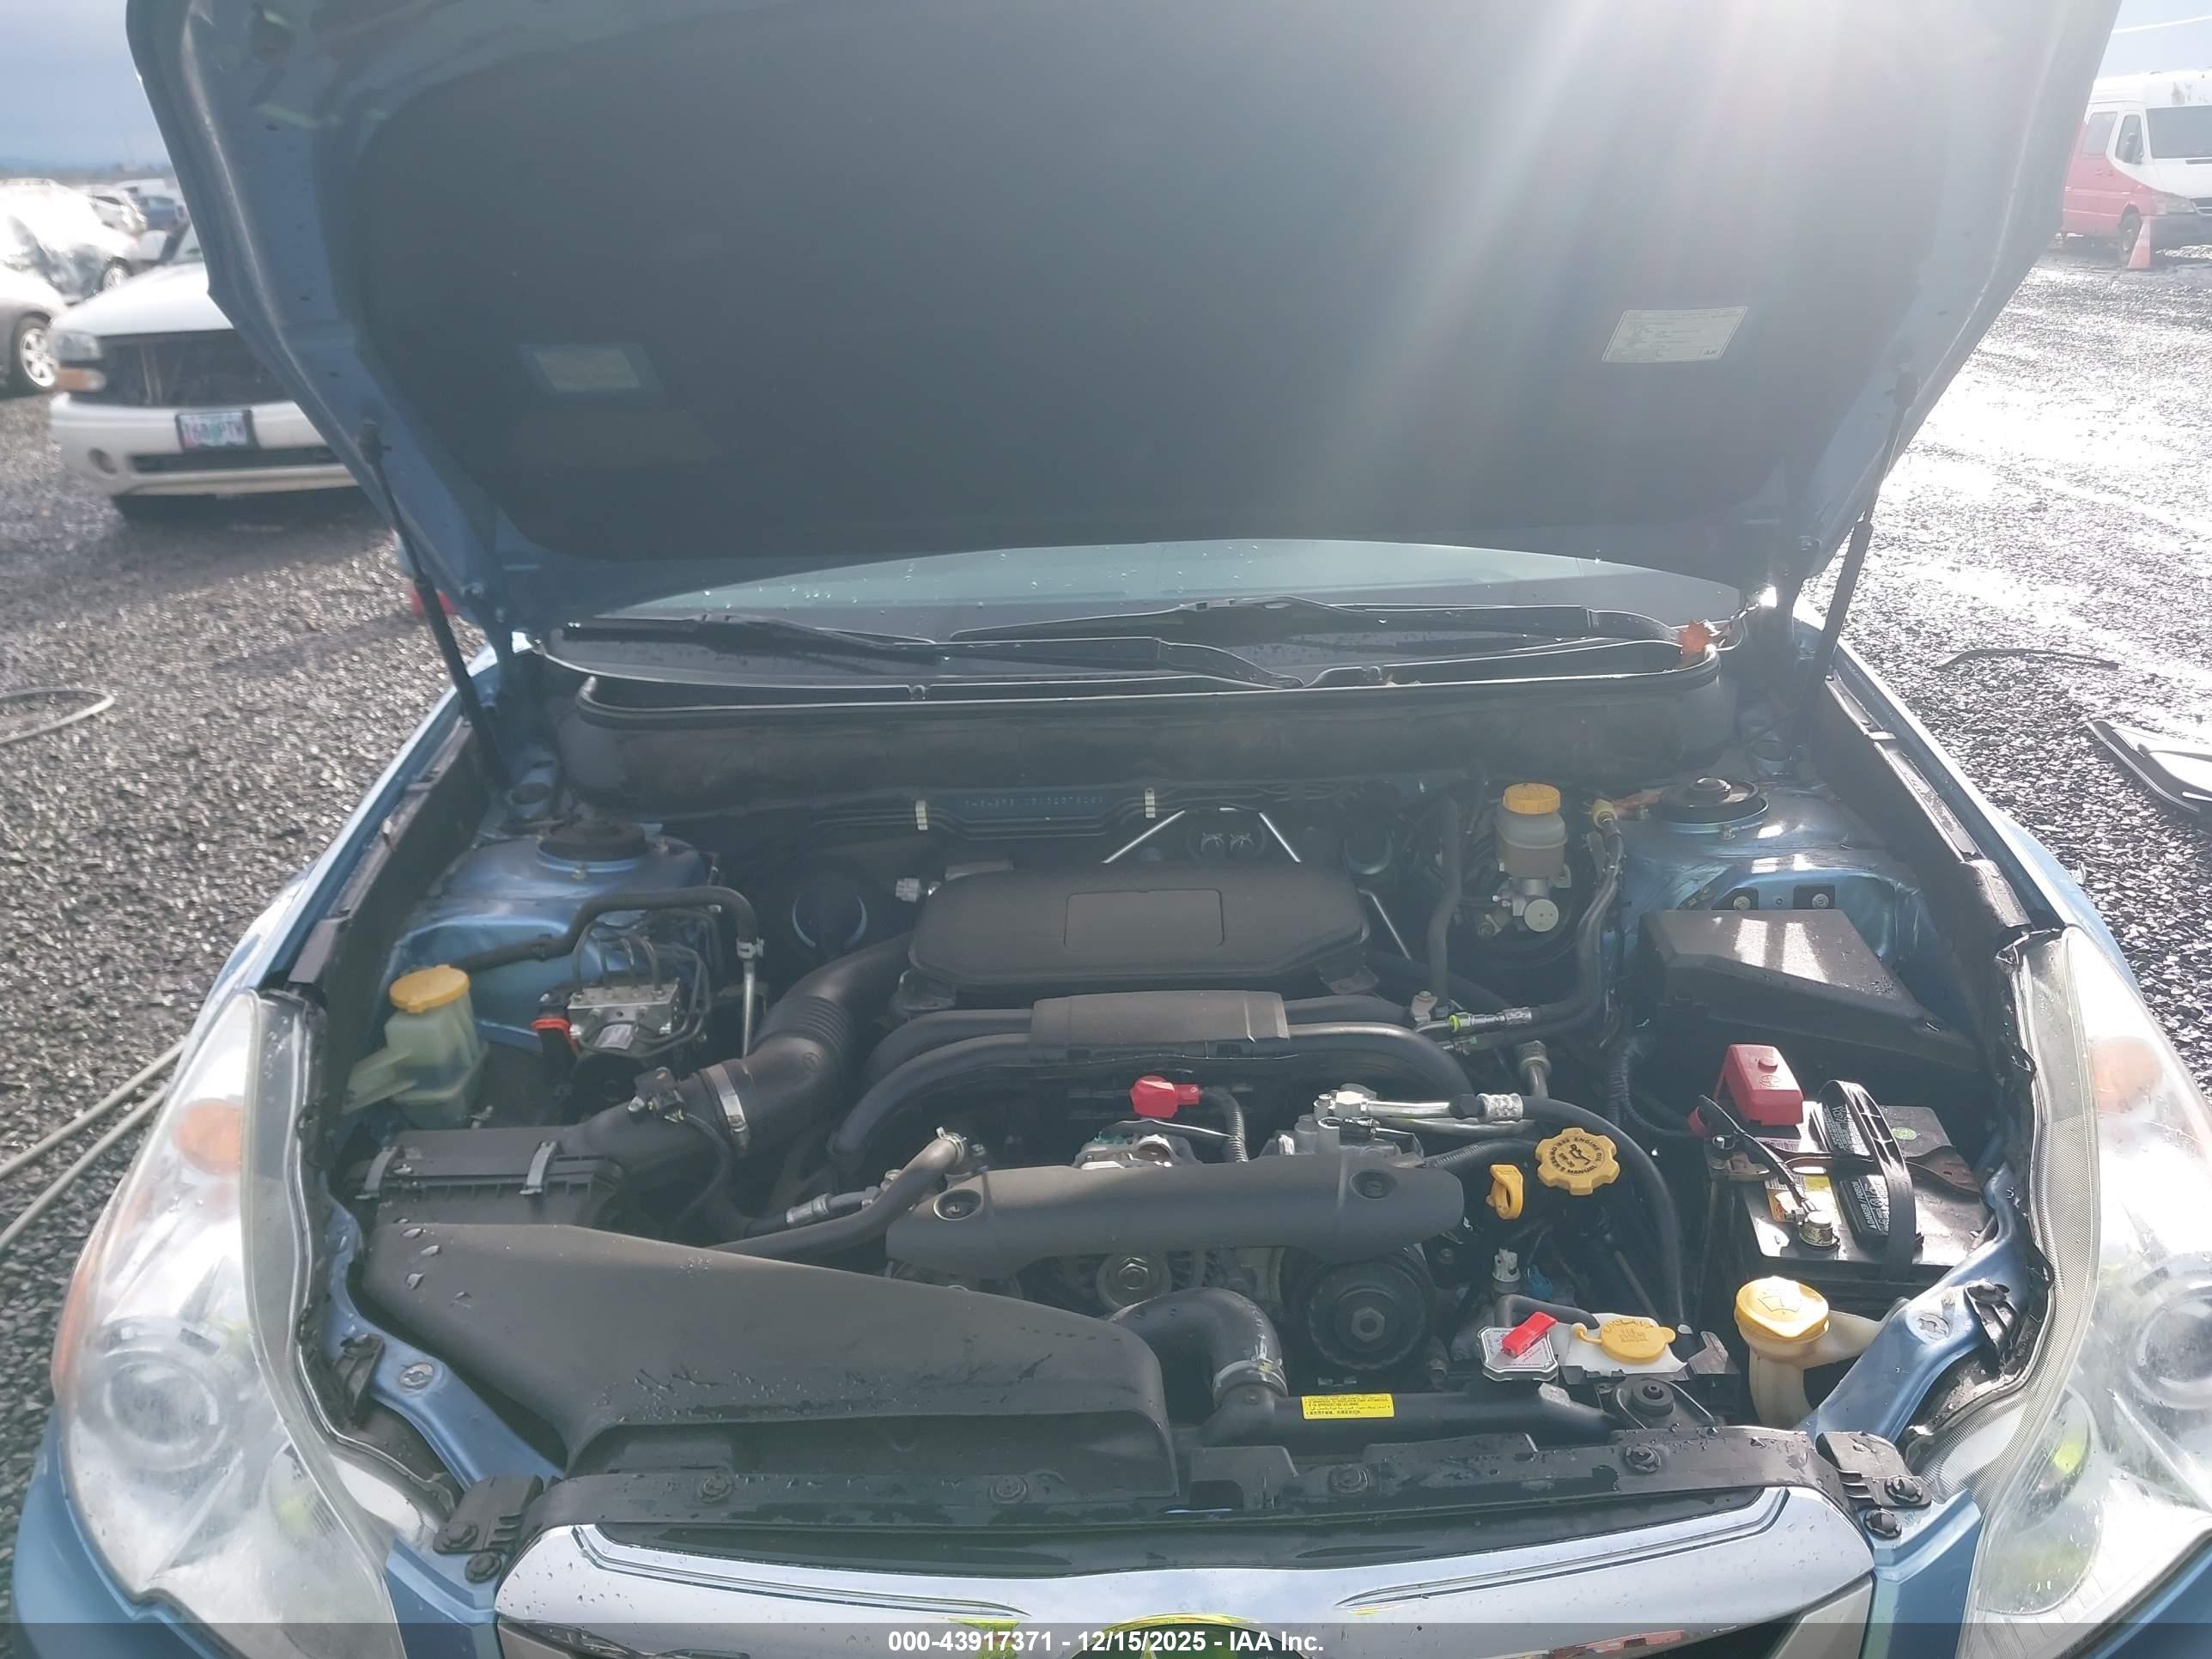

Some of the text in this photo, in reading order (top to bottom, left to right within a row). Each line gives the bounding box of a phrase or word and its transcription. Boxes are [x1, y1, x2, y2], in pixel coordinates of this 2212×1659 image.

[1574, 1137, 1601, 1151] ENGINE
[1566, 1164, 1598, 1174] MANUAL
[1850, 1181, 1865, 1200] POISON
[1860, 1203, 1875, 1224] DANGER
